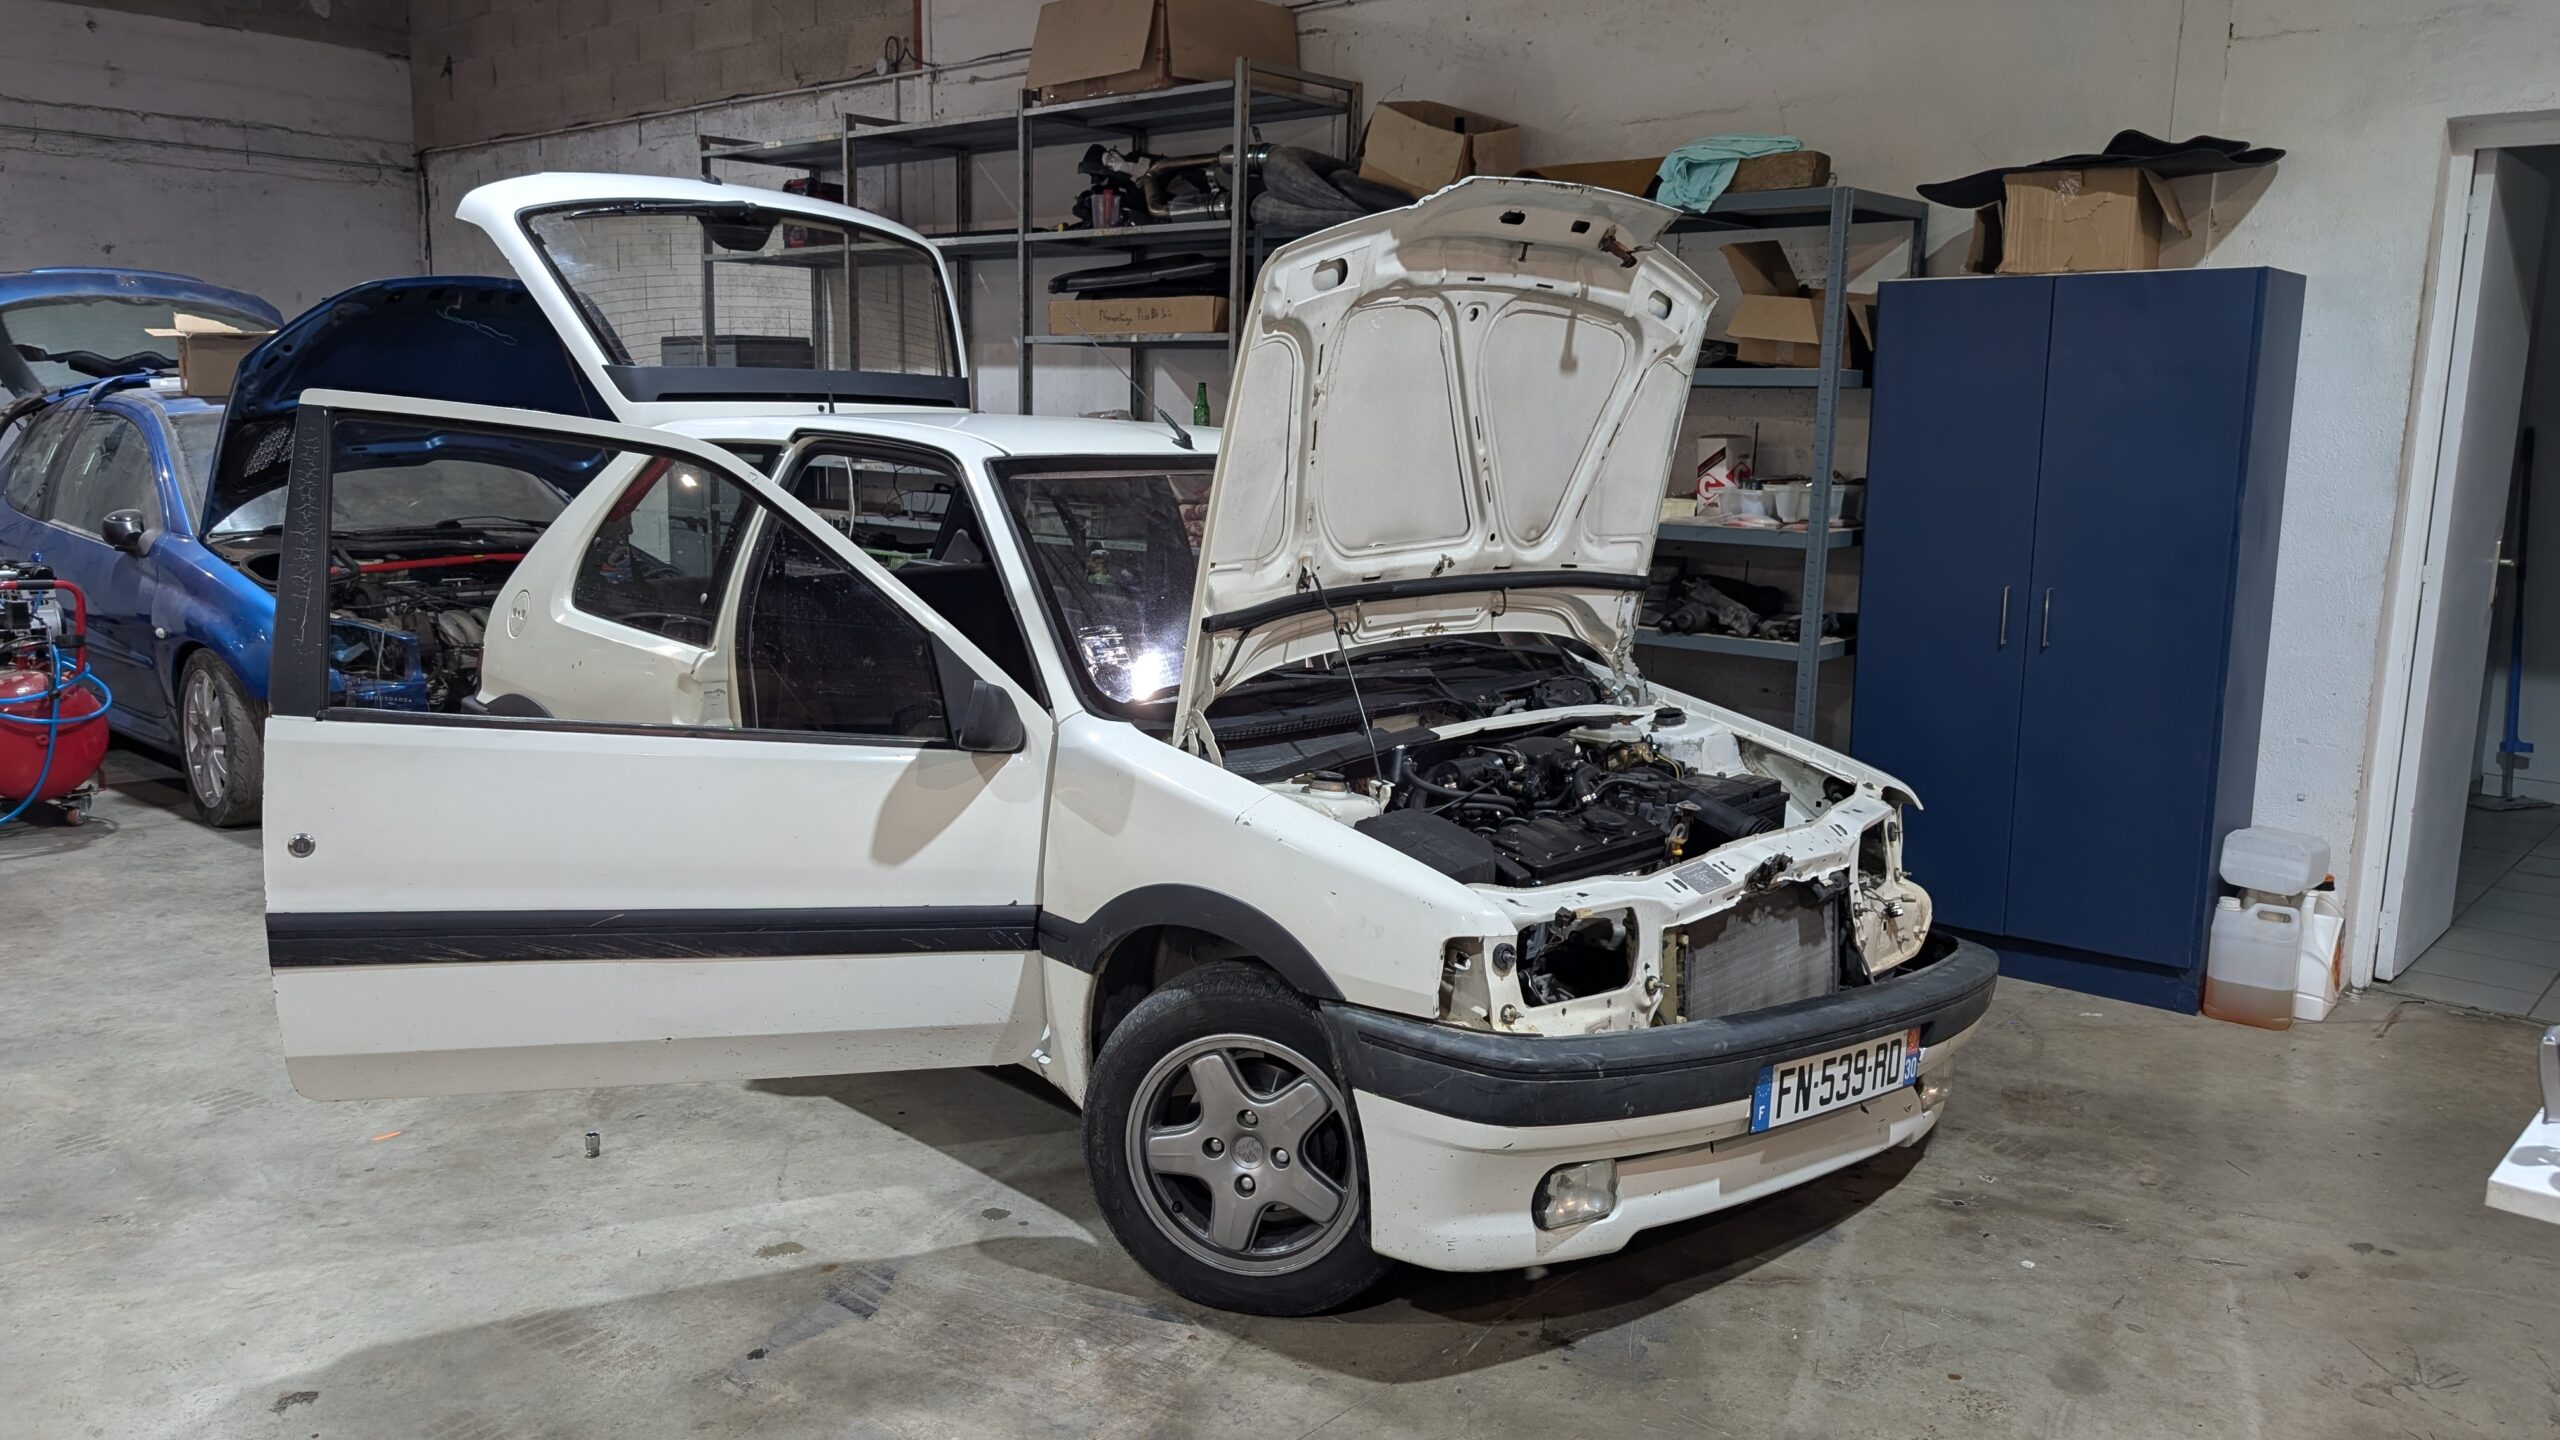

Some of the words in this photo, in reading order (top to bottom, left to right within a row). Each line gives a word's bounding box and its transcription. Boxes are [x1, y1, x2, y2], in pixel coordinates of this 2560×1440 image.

[1776, 1038, 1903, 1119] FN-539-RD
[1904, 1057, 1917, 1080] 30
[1758, 1105, 1766, 1121] F
